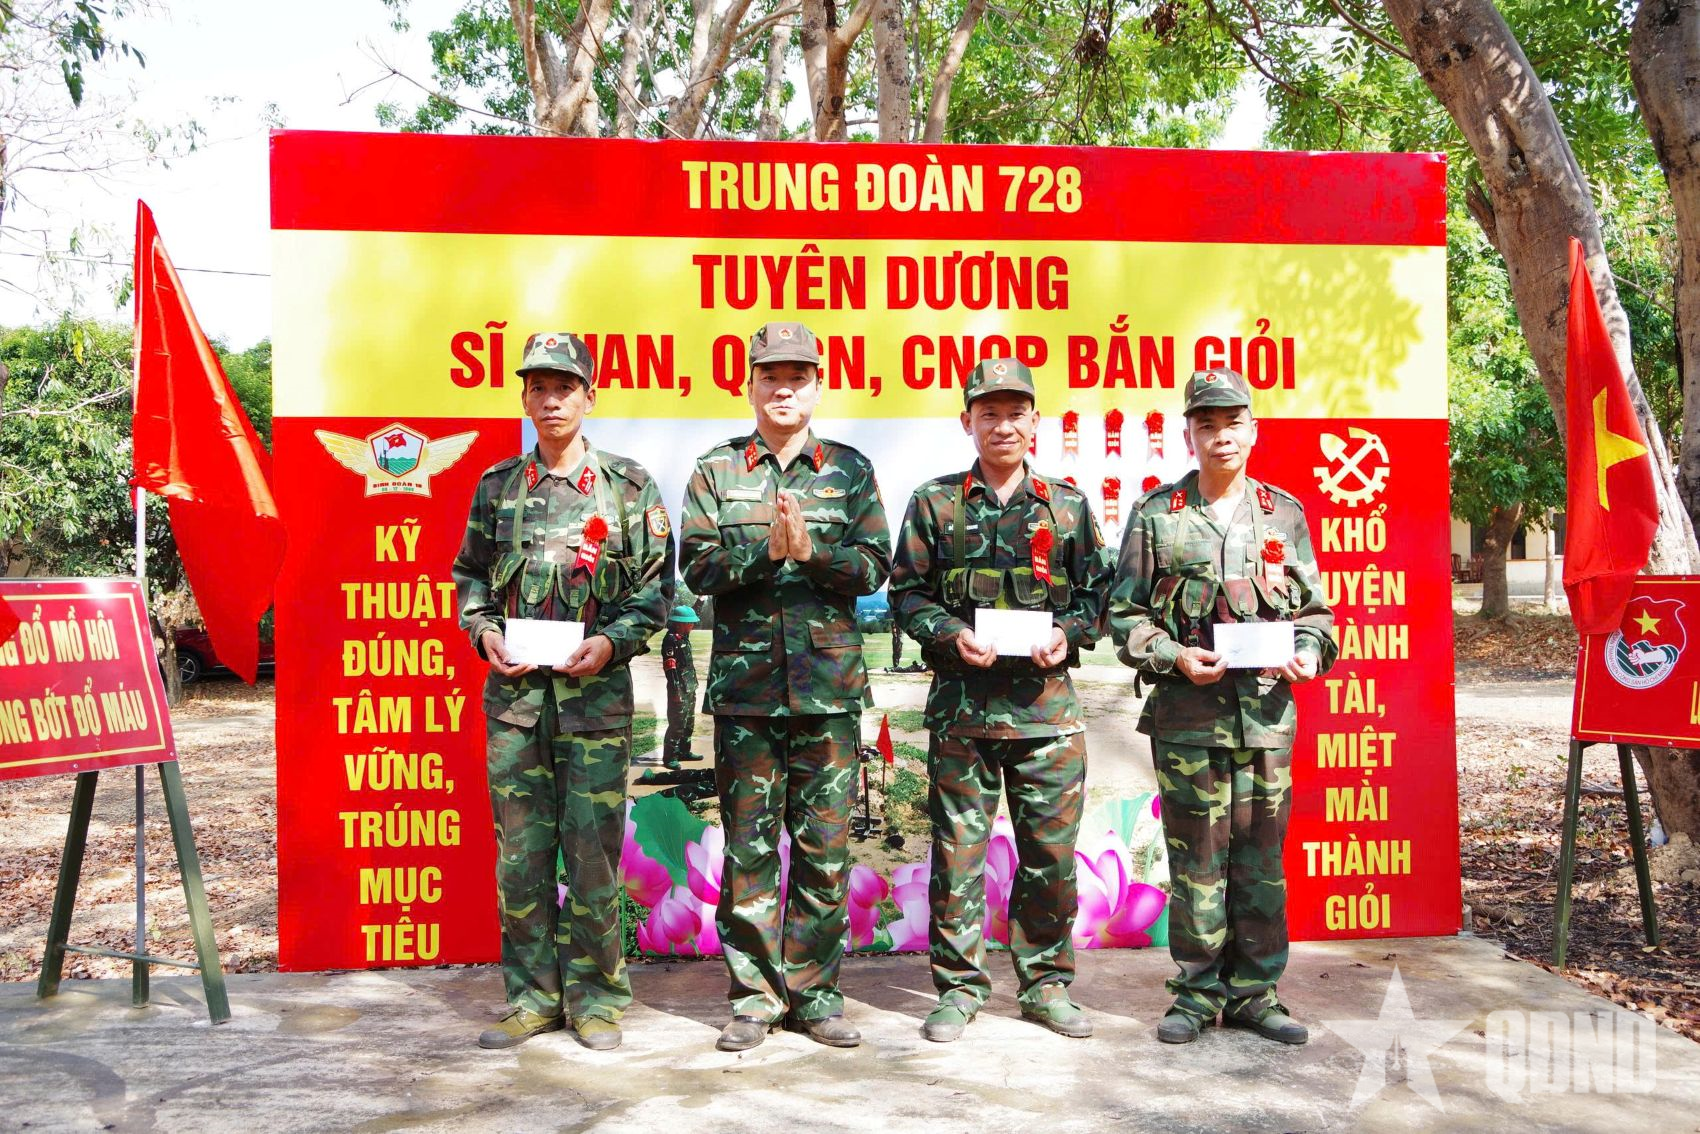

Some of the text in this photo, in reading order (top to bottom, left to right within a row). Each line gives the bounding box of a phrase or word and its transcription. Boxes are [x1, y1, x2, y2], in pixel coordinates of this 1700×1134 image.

[682, 154, 1083, 213] TRUNG ĐOÀN 728
[692, 243, 1069, 311] TUYÊN DƯƠNG
[450, 320, 508, 389] SĨ
[712, 334, 882, 397] QN,
[1067, 314, 1175, 389] BẮN
[1194, 317, 1296, 390] GIỎI
[375, 517, 422, 562] KỸ
[1321, 503, 1388, 553] KHỔ
[341, 574, 457, 628] THUẬT
[1321, 563, 1406, 614] UYỆN
[19, 604, 50, 665] ĐỔ
[49, 606, 85, 663] MỒ
[84, 610, 120, 661] HÔI
[342, 631, 456, 681] ĐÚNG,
[1332, 617, 1409, 660] ÀNH
[30, 688, 72, 741] BỚT
[71, 677, 102, 737] ĐỔ
[101, 682, 148, 734] MÁU
[332, 687, 466, 734] TÂM LÝ
[1324, 671, 1387, 718] TÀI,
[344, 746, 455, 794] VỮNG,
[1317, 725, 1397, 776] MIỆT
[1325, 779, 1389, 822] MÀI
[338, 802, 460, 849] TRÚNG
[1302, 833, 1411, 877] THÀNH
[359, 866, 442, 912] MỤC
[1325, 882, 1391, 931] GIỎI
[360, 916, 440, 961] TIÊU
